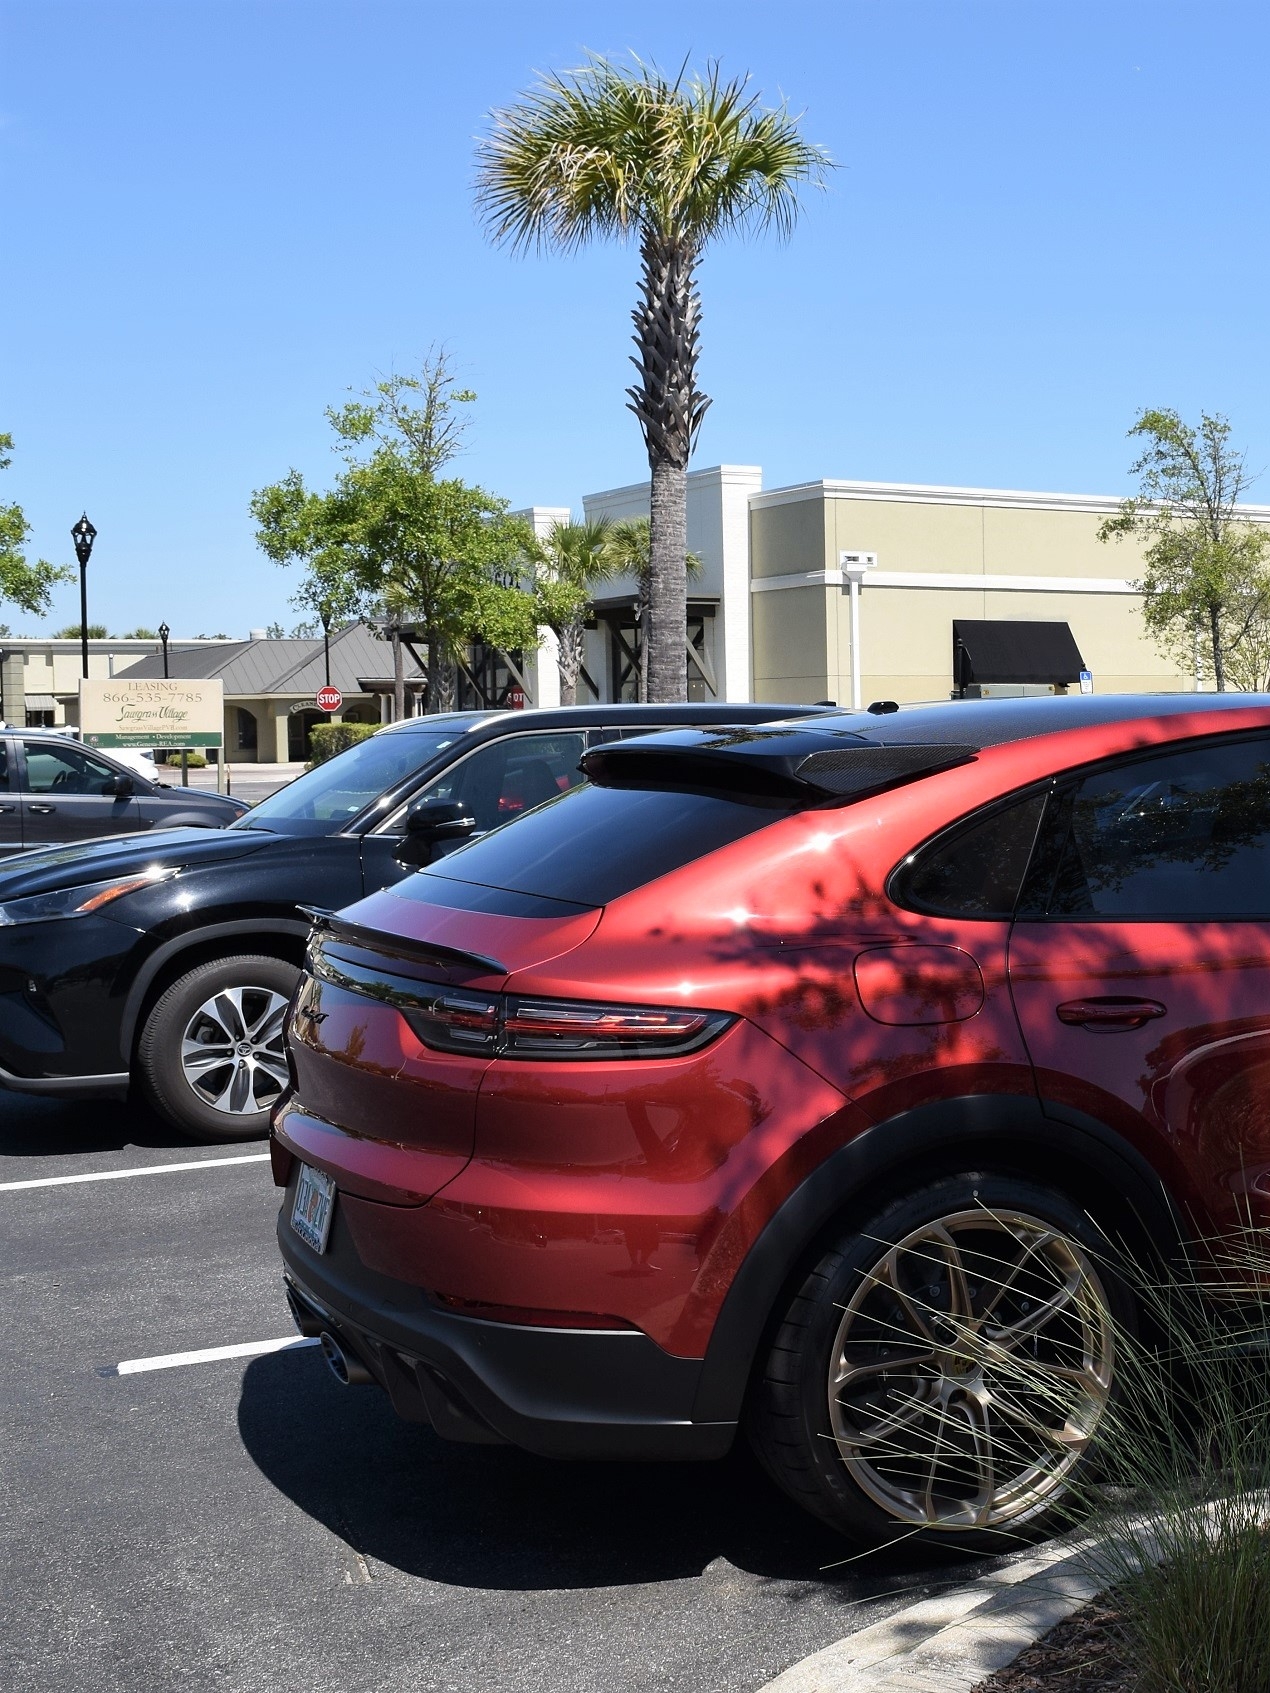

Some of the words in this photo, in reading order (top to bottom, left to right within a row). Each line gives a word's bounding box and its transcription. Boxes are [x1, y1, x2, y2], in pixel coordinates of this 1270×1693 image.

[128, 682, 178, 691] LEASING
[103, 693, 203, 703] 866-535-7785
[319, 693, 340, 704] STOP
[115, 703, 158, 723] Sawgrass
[158, 705, 191, 723] Village
